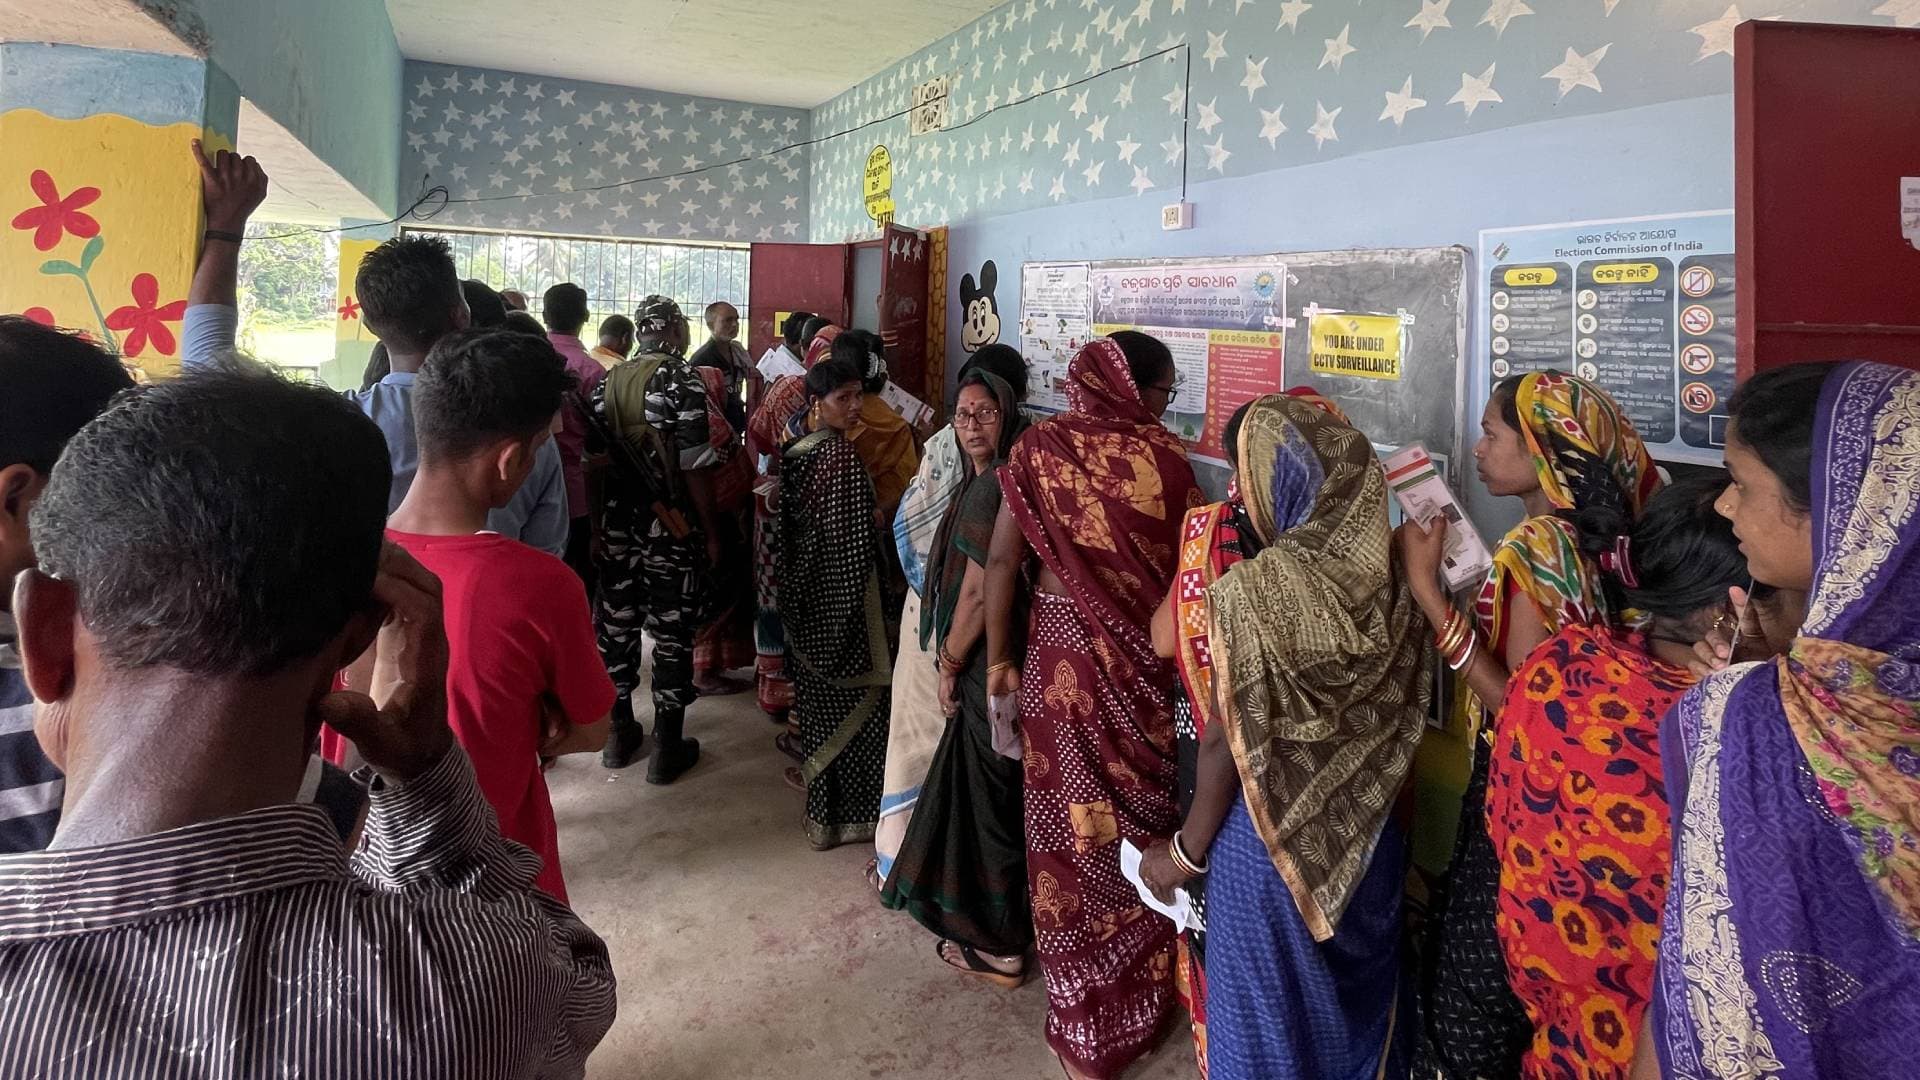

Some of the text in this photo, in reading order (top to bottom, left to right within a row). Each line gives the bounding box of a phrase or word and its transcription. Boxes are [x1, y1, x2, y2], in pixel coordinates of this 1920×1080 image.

[1554, 240, 1703, 258] Election Commission of India
[1121, 275, 1237, 293] ବଜ୍ରପାତ ପ୍ରତି ସାବଧାନ
[1324, 334, 1385, 352] YOU ARE UNDER
[1314, 353, 1396, 375] CCTV SURVEILLANCE
